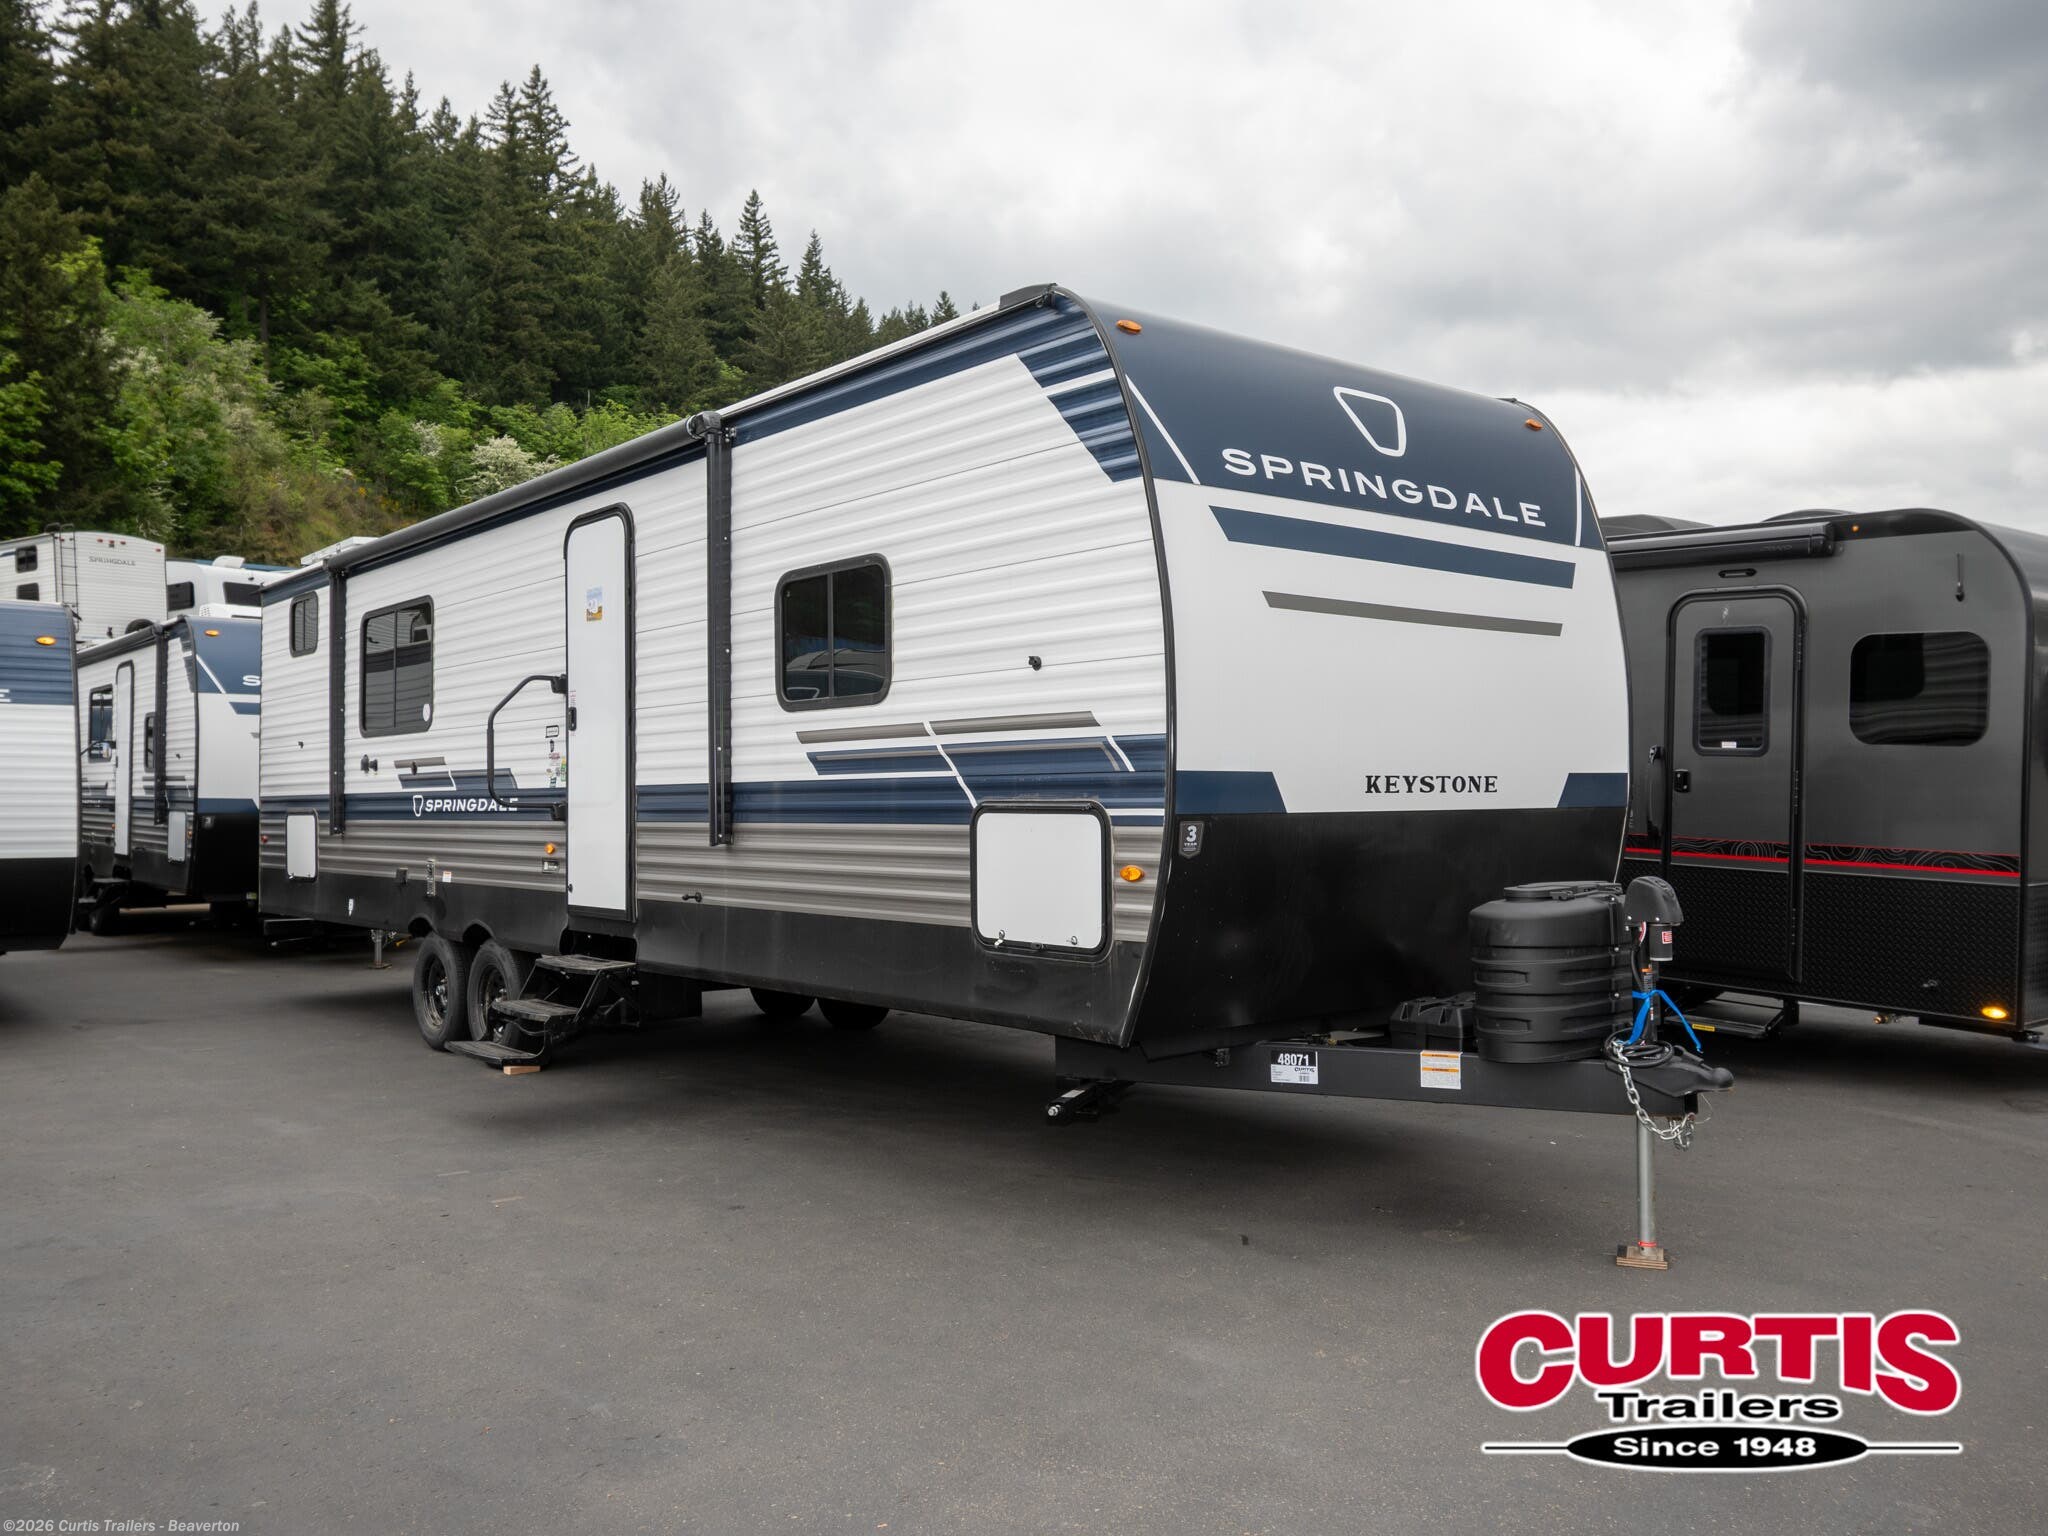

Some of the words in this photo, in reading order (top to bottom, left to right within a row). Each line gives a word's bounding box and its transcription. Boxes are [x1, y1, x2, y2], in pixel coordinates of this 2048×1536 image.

[1221, 448, 1547, 528] SPRINGDALE
[1364, 775, 1498, 794] KEYSTONE
[1186, 825, 1197, 842] 3
[1277, 1053, 1309, 1066] 48071
